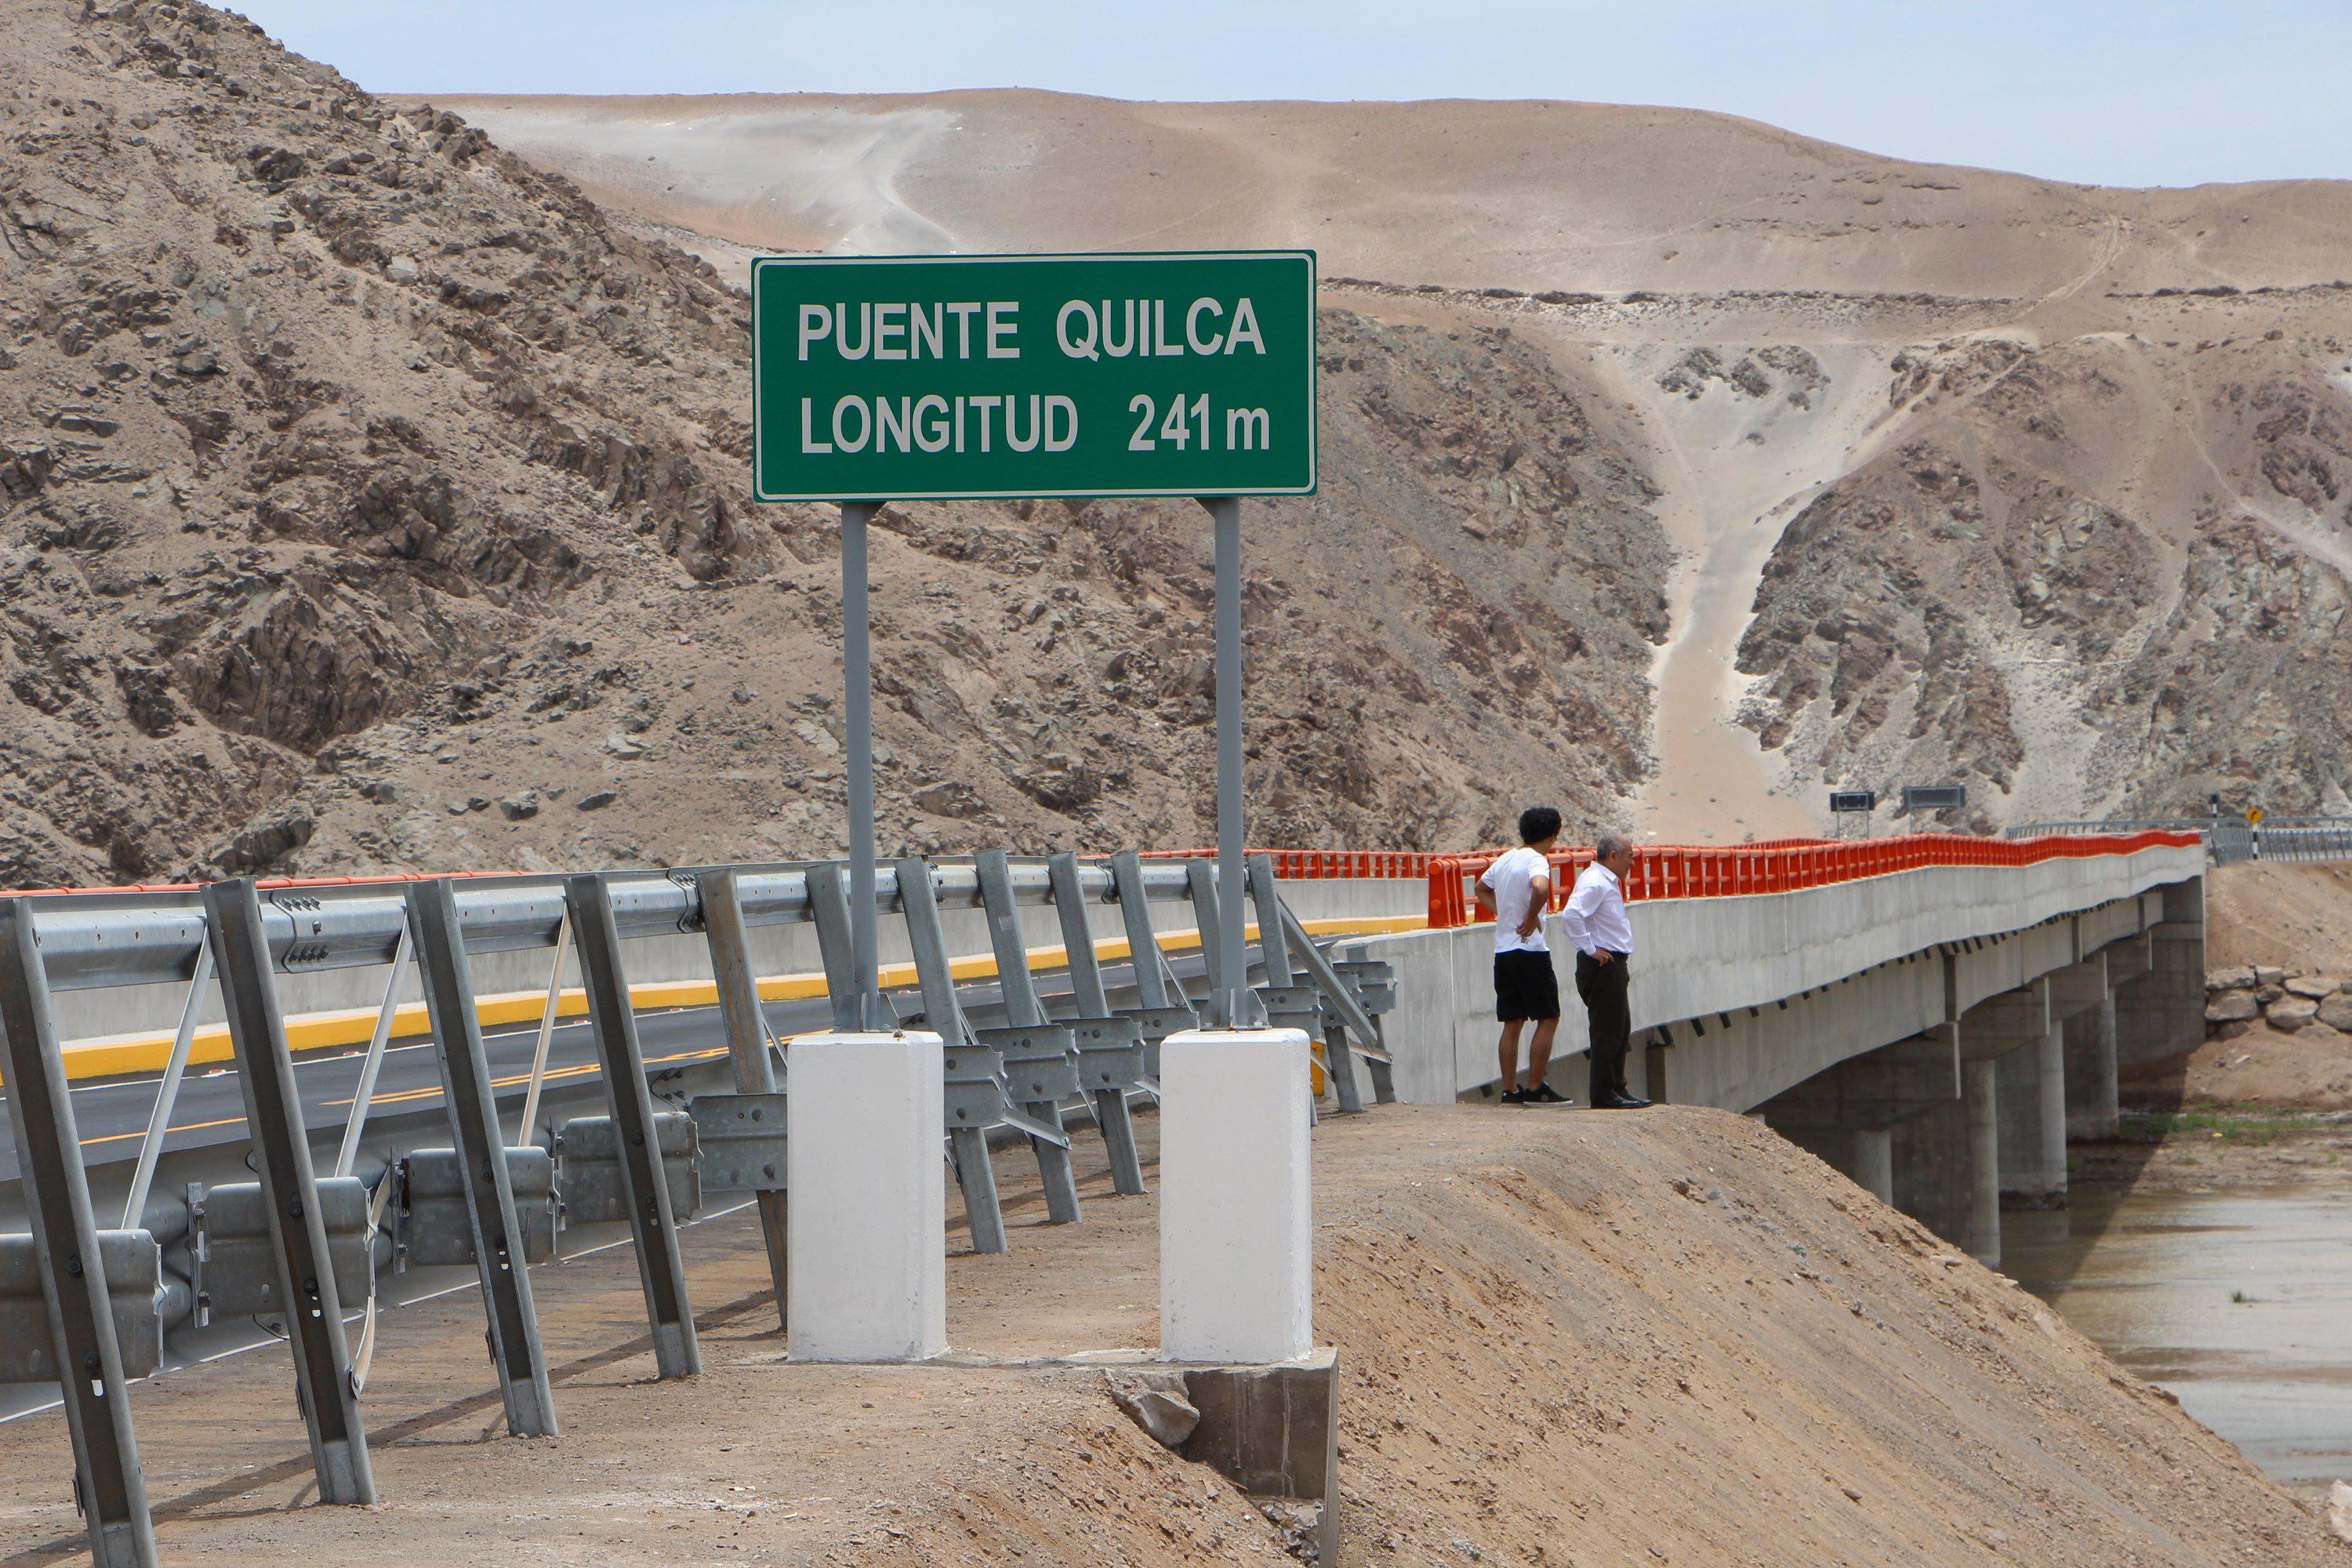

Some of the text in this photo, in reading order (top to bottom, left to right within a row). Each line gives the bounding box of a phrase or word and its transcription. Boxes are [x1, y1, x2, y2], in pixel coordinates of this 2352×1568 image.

[798, 297, 1267, 362] PUENTE QUILCA
[800, 393, 1270, 454] LONGITUD 241 m
